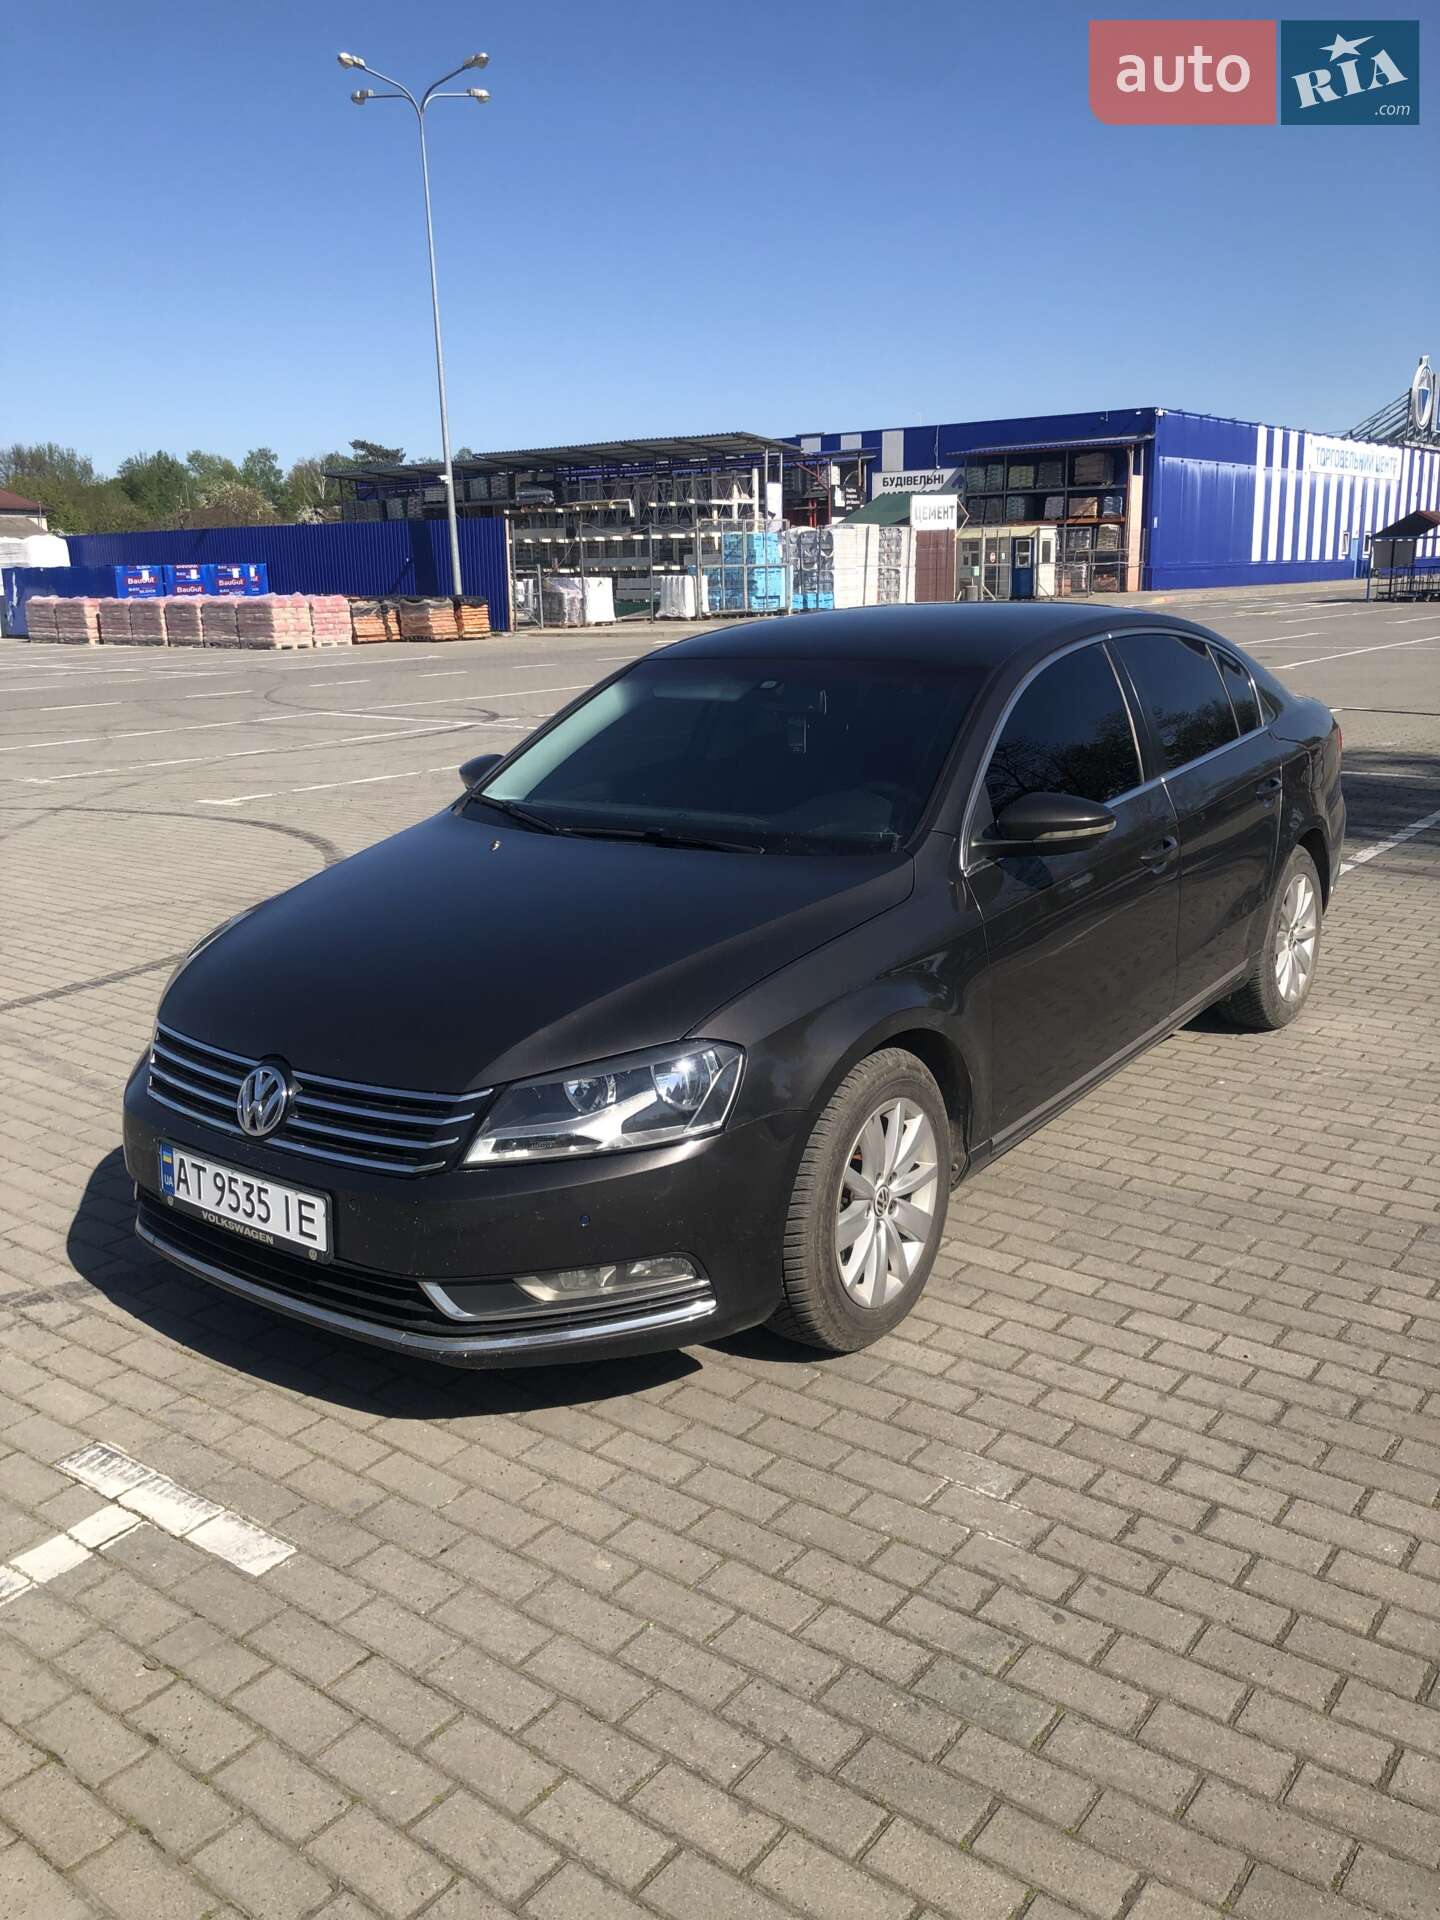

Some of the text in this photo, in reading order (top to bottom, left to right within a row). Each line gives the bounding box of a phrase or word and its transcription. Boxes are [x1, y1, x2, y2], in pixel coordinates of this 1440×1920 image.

[882, 474, 943, 488] БУДІВЕЛЬНІ
[915, 506, 955, 522] ЦЕМЕНТ
[164, 1174, 174, 1187] UA
[176, 1157, 318, 1241] AT 9535 IE
[201, 1210, 274, 1245] VOLKSWAGEN
